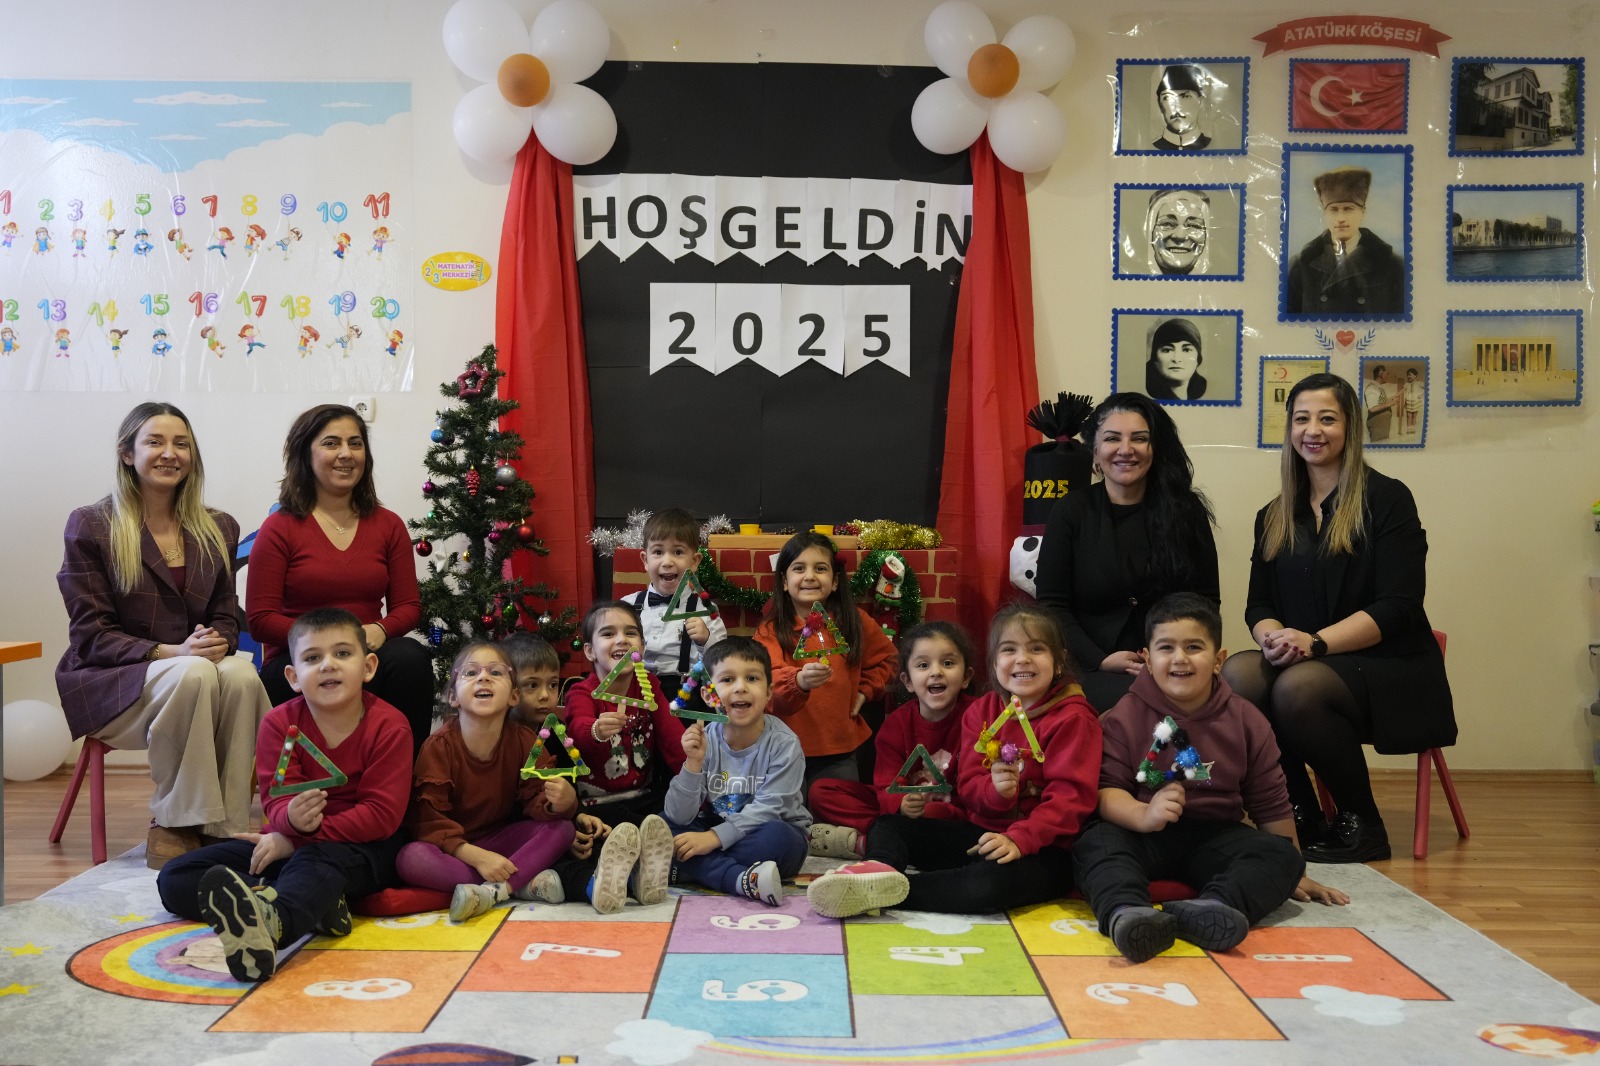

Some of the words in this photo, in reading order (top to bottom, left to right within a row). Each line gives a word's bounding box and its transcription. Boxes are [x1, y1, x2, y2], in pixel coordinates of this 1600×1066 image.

[1284, 22, 1357, 43] ATATÜRK
[1360, 22, 1422, 43] KÖŞESİ
[0, 190, 12, 215] 1
[38, 199, 54, 221] 2
[68, 199, 83, 221] 3
[100, 197, 115, 222] 4
[135, 194, 150, 216] 5
[172, 195, 186, 216] 6
[202, 195, 218, 218] 7
[241, 195, 257, 216] 8
[281, 194, 297, 215] 9
[317, 202, 348, 223] 10
[363, 192, 390, 219] 11
[582, 194, 973, 257] HOŞGELDİN
[37, 299, 67, 321] 13
[88, 300, 118, 326] 14
[140, 294, 170, 316] 15
[189, 291, 218, 317] 16
[236, 291, 267, 318] 17
[281, 295, 311, 320] 18
[329, 291, 357, 317] 19
[370, 296, 400, 320] 20
[668, 311, 891, 358] 2025
[1023, 479, 1069, 499] 2025
[520, 942, 622, 961] 7
[888, 946, 985, 966] 4
[303, 977, 413, 1000] 8
[702, 979, 809, 1002] 5
[1085, 982, 1199, 1006] 2
